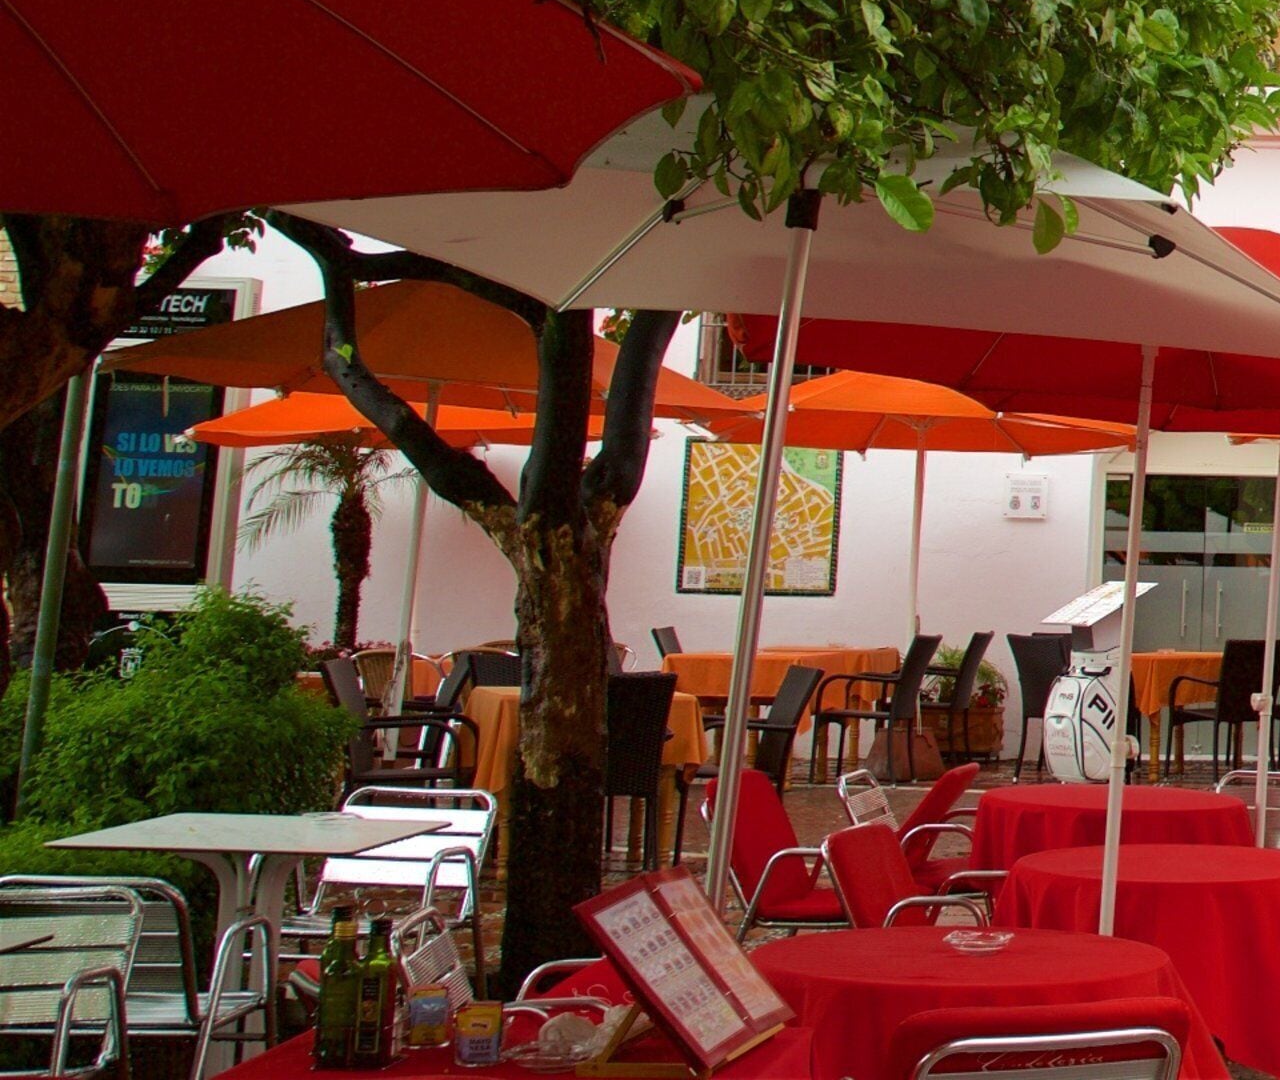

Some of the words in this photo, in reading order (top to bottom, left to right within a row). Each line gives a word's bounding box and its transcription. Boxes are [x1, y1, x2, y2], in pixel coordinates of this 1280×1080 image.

[117, 433, 136, 452] SI
[140, 433, 160, 452] LO
[115, 459, 134, 476] LO
[137, 459, 195, 477] VEMOS
